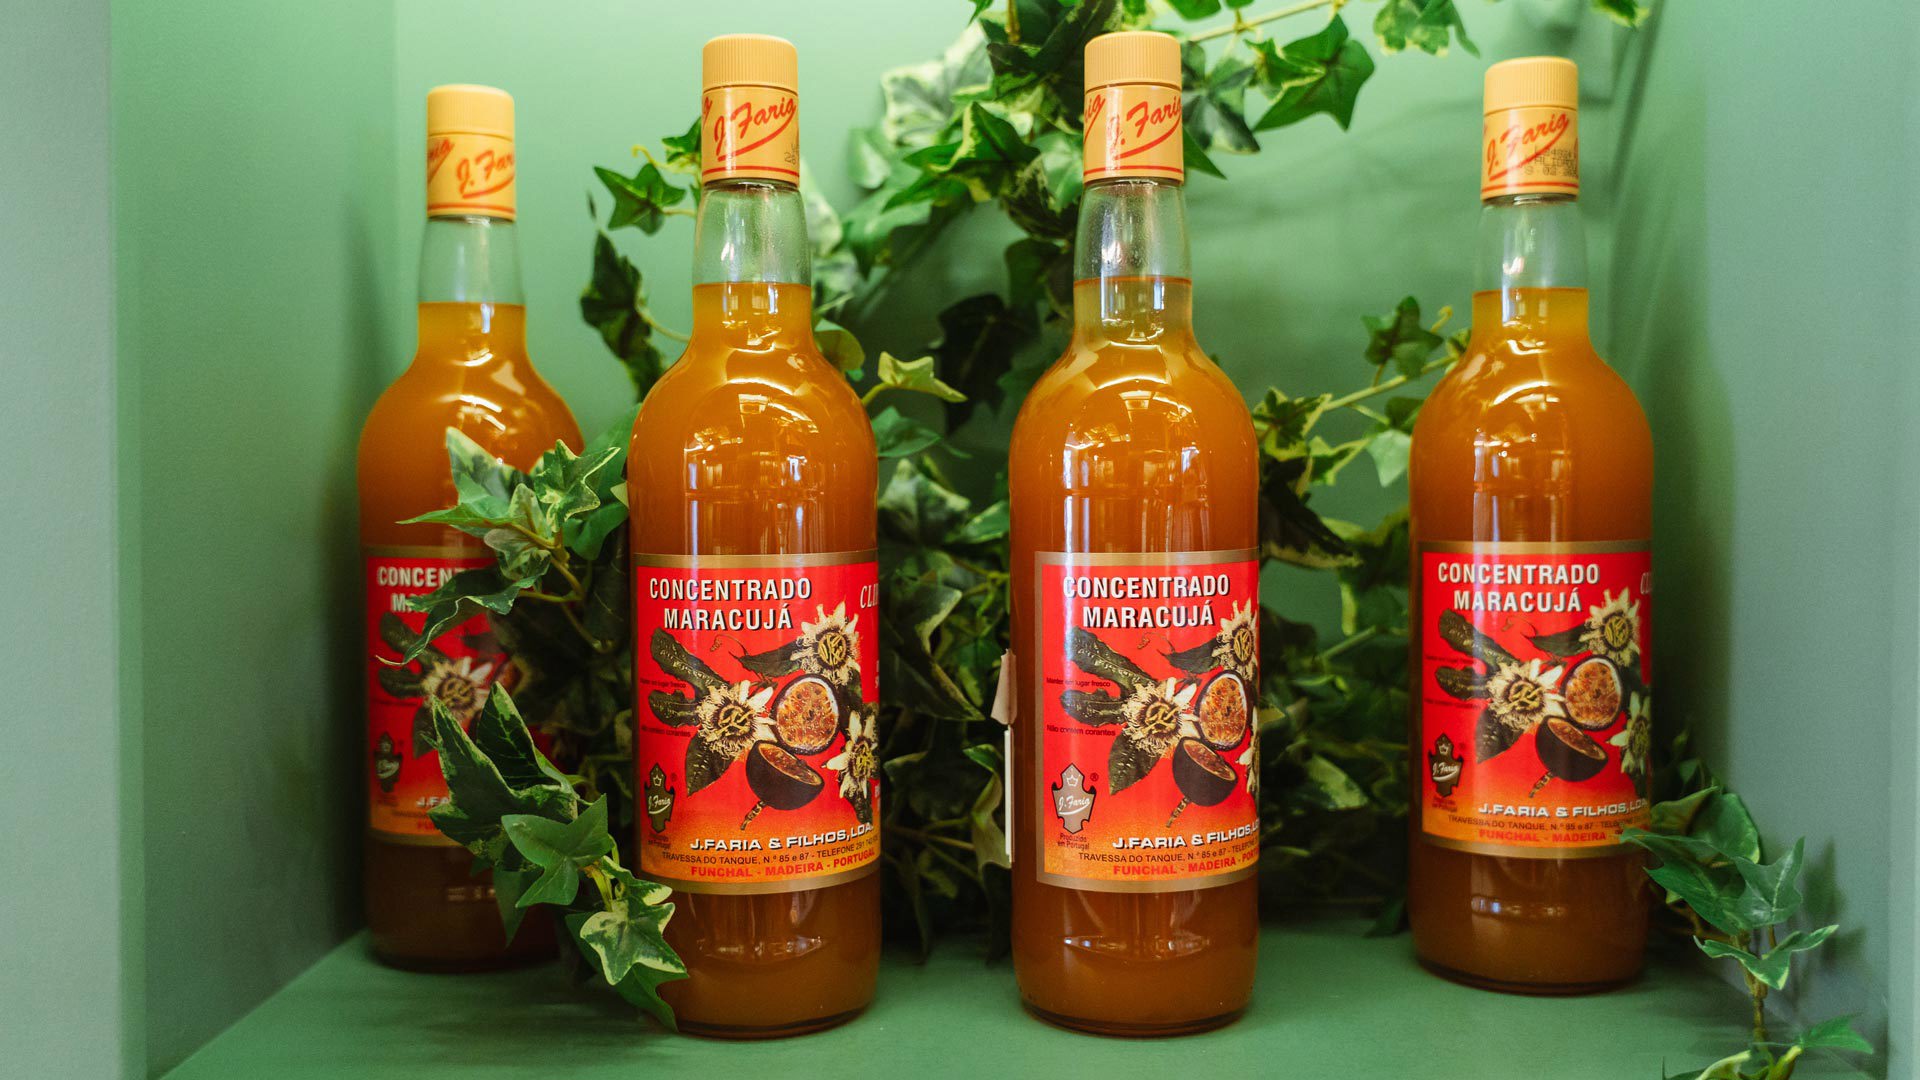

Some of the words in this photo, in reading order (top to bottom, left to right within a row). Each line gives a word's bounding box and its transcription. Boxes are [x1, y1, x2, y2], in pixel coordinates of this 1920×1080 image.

[377, 566, 466, 588] CONCEN
[1438, 562, 1600, 585] CONCENTRADO
[650, 577, 812, 601] CONCENTRADO
[1063, 574, 1229, 599] CONCENTRADO
[1453, 587, 1582, 613] MARACUJÁ
[664, 603, 793, 631] MARACUJÁ
[1083, 600, 1214, 629] MARACUJÁ
[1478, 803, 1549, 817] J.FARIA
[1555, 806, 1569, 818] &
[690, 838, 763, 851] J.FARIA
[768, 837, 783, 850] &
[1112, 835, 1187, 849] J.FARIA
[1191, 834, 1205, 846] &
[1478, 829, 1540, 842] FUNCHAL
[1552, 832, 1607, 843] MADEIRA
[703, 855, 717, 864] DO
[779, 853, 790, 863] 85
[792, 854, 797, 862] e
[799, 852, 810, 861] 87
[816, 843, 855, 858] TELEFONE
[1079, 852, 1127, 862] TRAVESSA
[1128, 854, 1143, 863] DO
[691, 866, 753, 877] FUNCHAL
[765, 861, 824, 876] MADEIRA
[1113, 865, 1177, 876] FUNCHAL
[1188, 856, 1236, 872] MADEIRA
